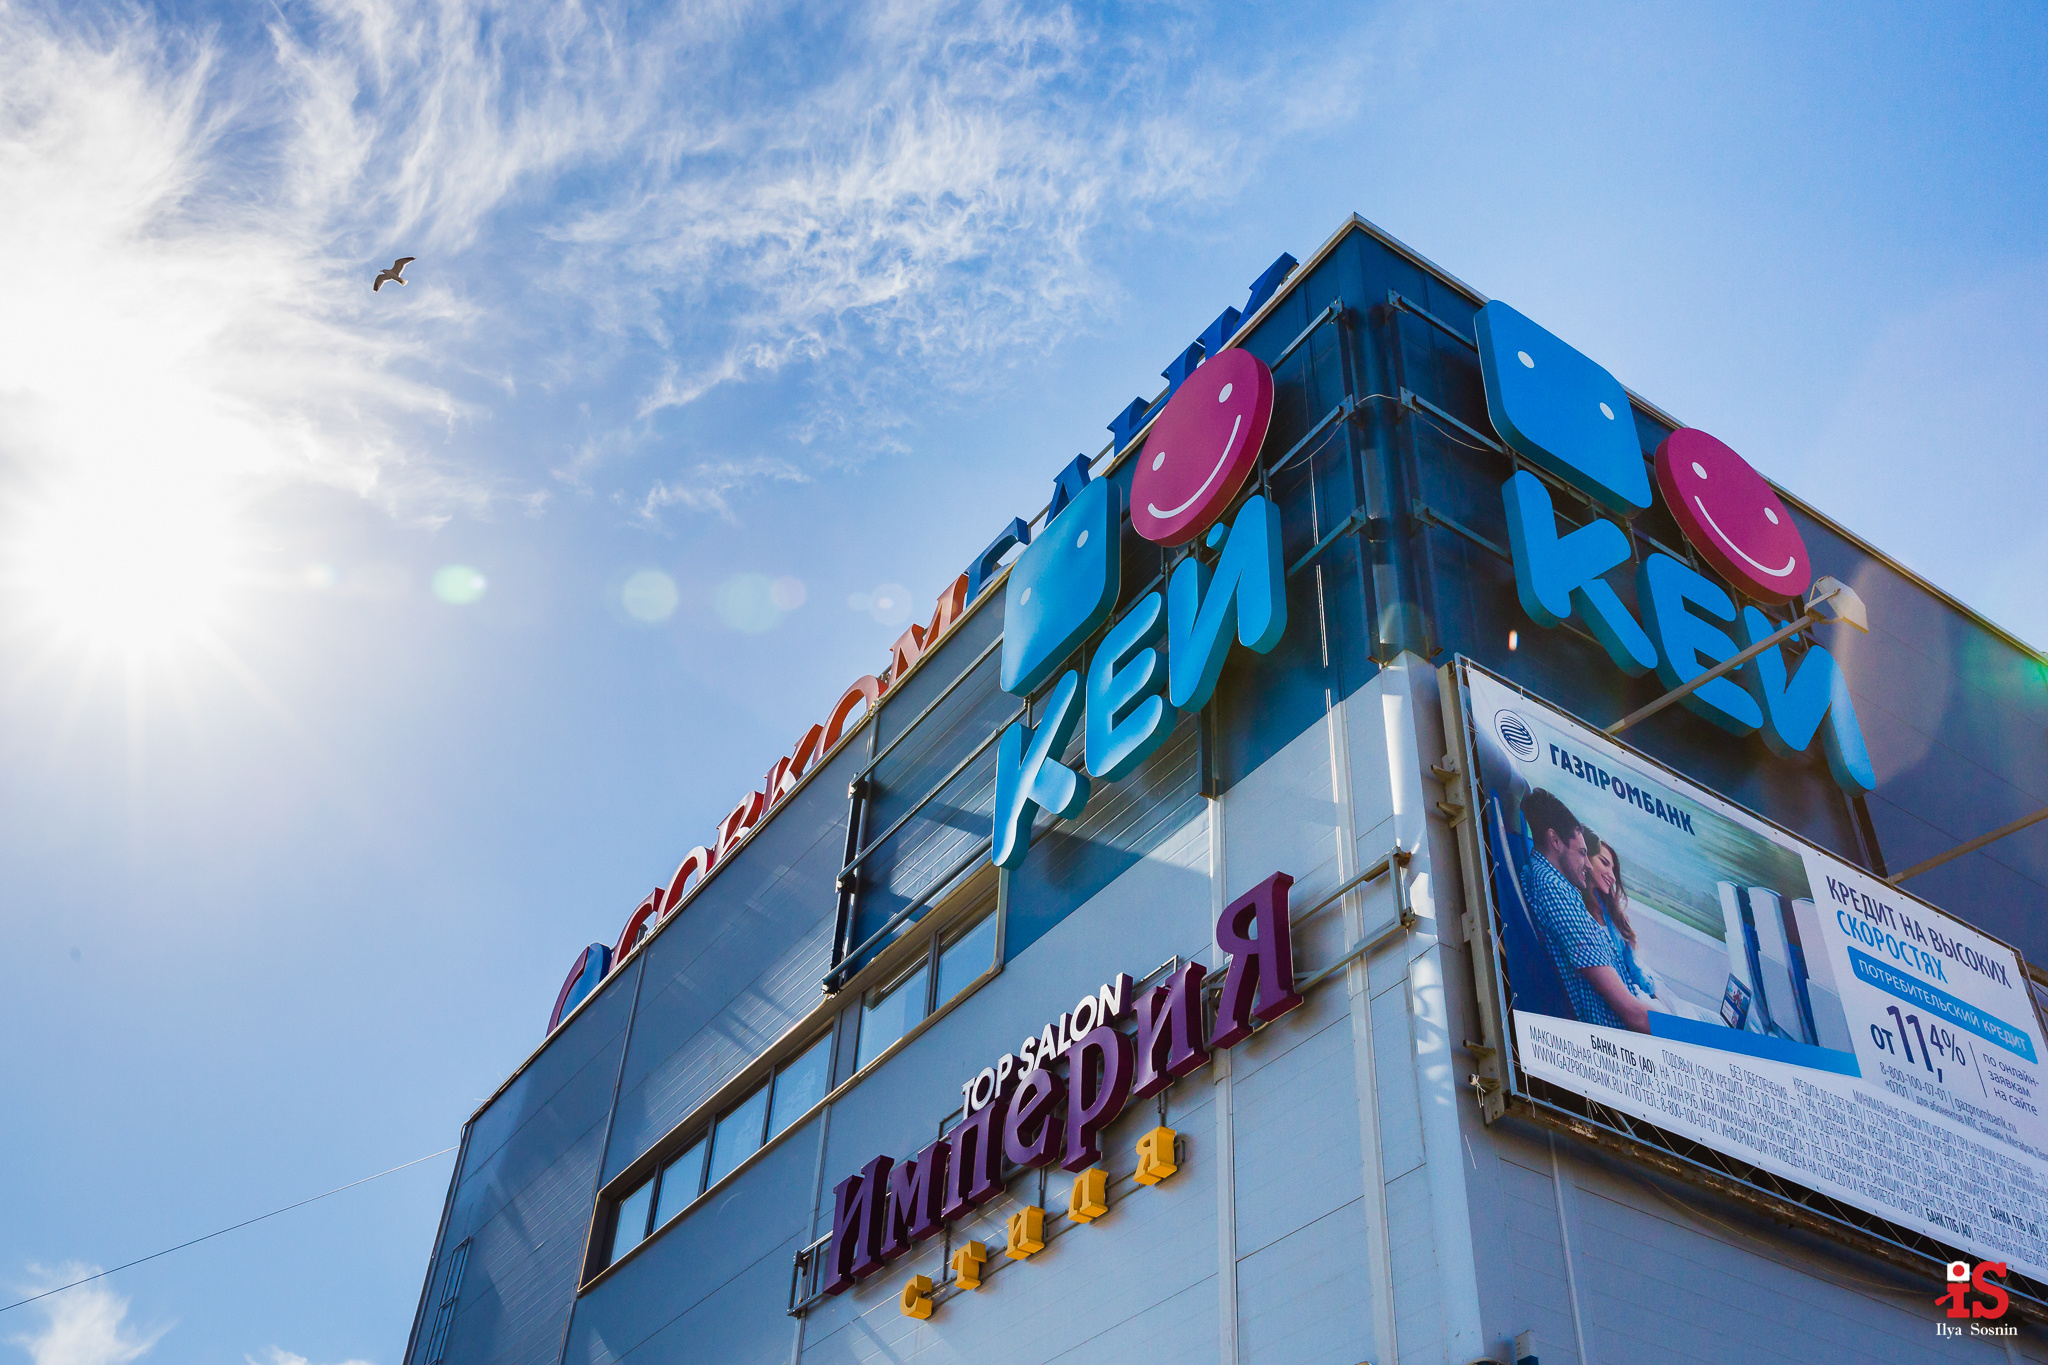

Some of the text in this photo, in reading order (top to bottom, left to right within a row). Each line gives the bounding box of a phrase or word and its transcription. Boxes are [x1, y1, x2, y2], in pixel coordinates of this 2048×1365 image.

[1501, 469, 1876, 797] КЕЙ
[993, 495, 1287, 869] КЕЙ
[1549, 743, 1695, 836] ГАЗПРОМБАНК
[1825, 875, 2012, 989] КРЕДИТ НА ВЫСОКИХ
[1836, 910, 1949, 985] СКОРОСТЯХ
[961, 972, 1133, 1121] TOP SALON
[1858, 958, 2028, 1052] ПОТРЕБИТЕЛЬСКИЙ КРЕДИТ
[1870, 1023, 1895, 1056] от
[1528, 1025, 1592, 1063] МАКСИМАЛЬНАЯ
[1592, 1052, 1621, 1075] СУММА
[1620, 1064, 1655, 1090] КРЕДИТА:
[1654, 1078, 1666, 1096] 3,5
[1665, 1082, 1684, 1101] МЛН
[1683, 1090, 1699, 1107] РУБ.
[1698, 1094, 1758, 1132] МАКСИМАЛЬНЫЙ
[1758, 1122, 1775, 1140] СРОК
[1774, 1130, 1807, 1155] КРЕДИТА:
[1810, 1145, 1825, 1161] ЛЕТ.
[1531, 1043, 1623, 1093] WWW.GAZPROMBANK.RU
[1641, 1088, 1659, 1108] ТЕЛ.:
[1659, 1095, 1719, 1132] 8-800-100-07-01.
[1719, 1121, 1769, 1154] ИНФОРМАЦИЯ
[1767, 1142, 1808, 1171] ПРИВЕДЕНА
[1817, 1162, 1853, 1189] 02.04.2018
[1590, 1035, 1618, 1058] БАНКА
[1620, 1048, 1636, 1066] ГПБ
[1700, 1082, 1714, 1098] БЕЗ
[1715, 1088, 1748, 1113] ЛИЧНОГО
[1747, 1102, 1796, 1135] СТРАХОВАНИЯ;
[1807, 1128, 1819, 1145] 0,5
[1879, 1062, 2018, 1134] 8-800-100-07-01 gazprombank.ru
[1916, 1096, 1928, 1107] для
[1930, 1101, 1965, 1124] абонентов
[1983, 1052, 2040, 1087] по онлайн-
[1987, 1070, 2032, 1098] заявкам
[1993, 1086, 2039, 1117] на сайте
